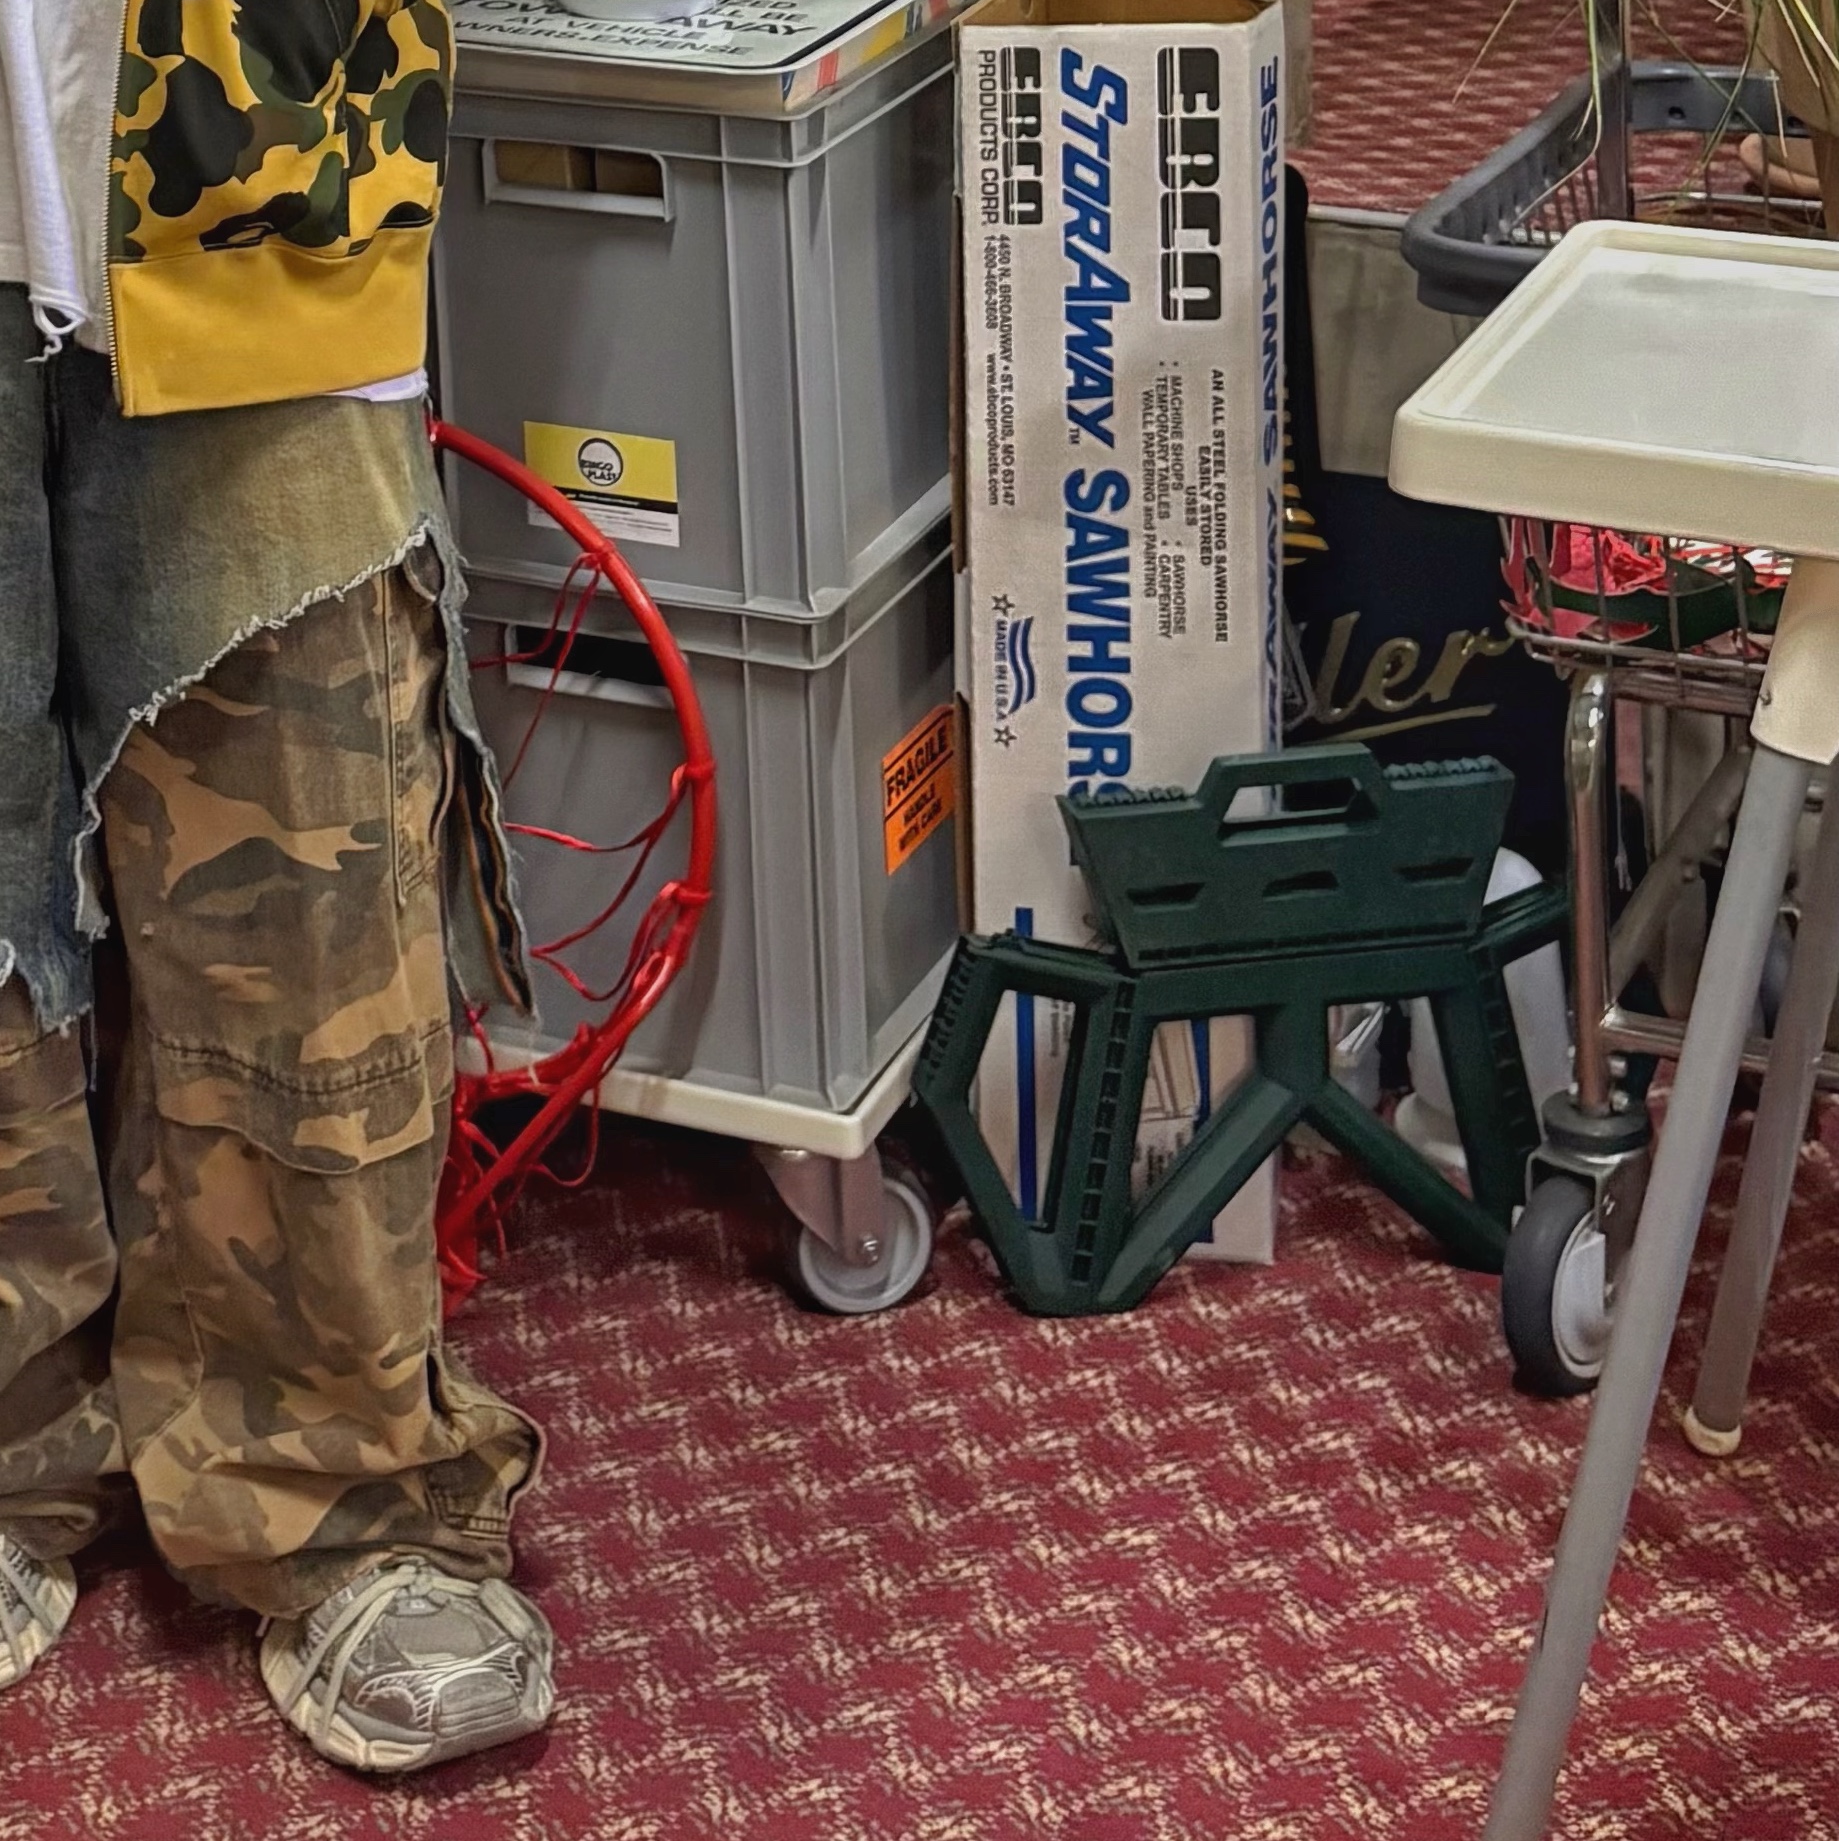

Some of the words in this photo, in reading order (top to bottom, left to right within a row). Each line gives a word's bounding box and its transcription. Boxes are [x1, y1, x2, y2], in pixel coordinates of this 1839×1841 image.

[564, 18, 707, 40] VEHICLE
[656, 16, 817, 35] AWAY
[979, 50, 999, 162] PRODUCTS
[980, 168, 999, 226] CORP.
[1260, 56, 1280, 467] SAWHORSE
[999, 284, 1013, 362] BROADWAY
[1141, 388, 1155, 430] WALL
[1170, 375, 1183, 440] MACHINE
[1211, 369, 1225, 392] AN
[1211, 396, 1225, 425] ALL
[984, 354, 1001, 507] www.ebcoproducts.com
[1155, 375, 1170, 462] TEMPORARY
[1002, 444, 1015, 466] MO
[1142, 431, 1156, 503] PAPERING
[1170, 443, 1184, 491] SHOPS
[1198, 445, 1212, 500] EASILY
[1212, 429, 1226, 478] STEEL
[1143, 505, 1156, 531] and
[1157, 466, 1171, 520] TABLES
[1184, 485, 1198, 527] USES
[1213, 482, 1227, 551] FOLDING
[1143, 533, 1157, 598] PAINTING
[1199, 504, 1213, 566] STORED
[1159, 553, 1172, 639] CARPENTRY
[1173, 554, 1186, 635] SAWHORSE
[1214, 554, 1228, 643] SAWHORSE
[995, 620, 1008, 661] MADE
[1062, 468, 1133, 805] SAWHOR
[886, 724, 948, 807] FRAGILE
